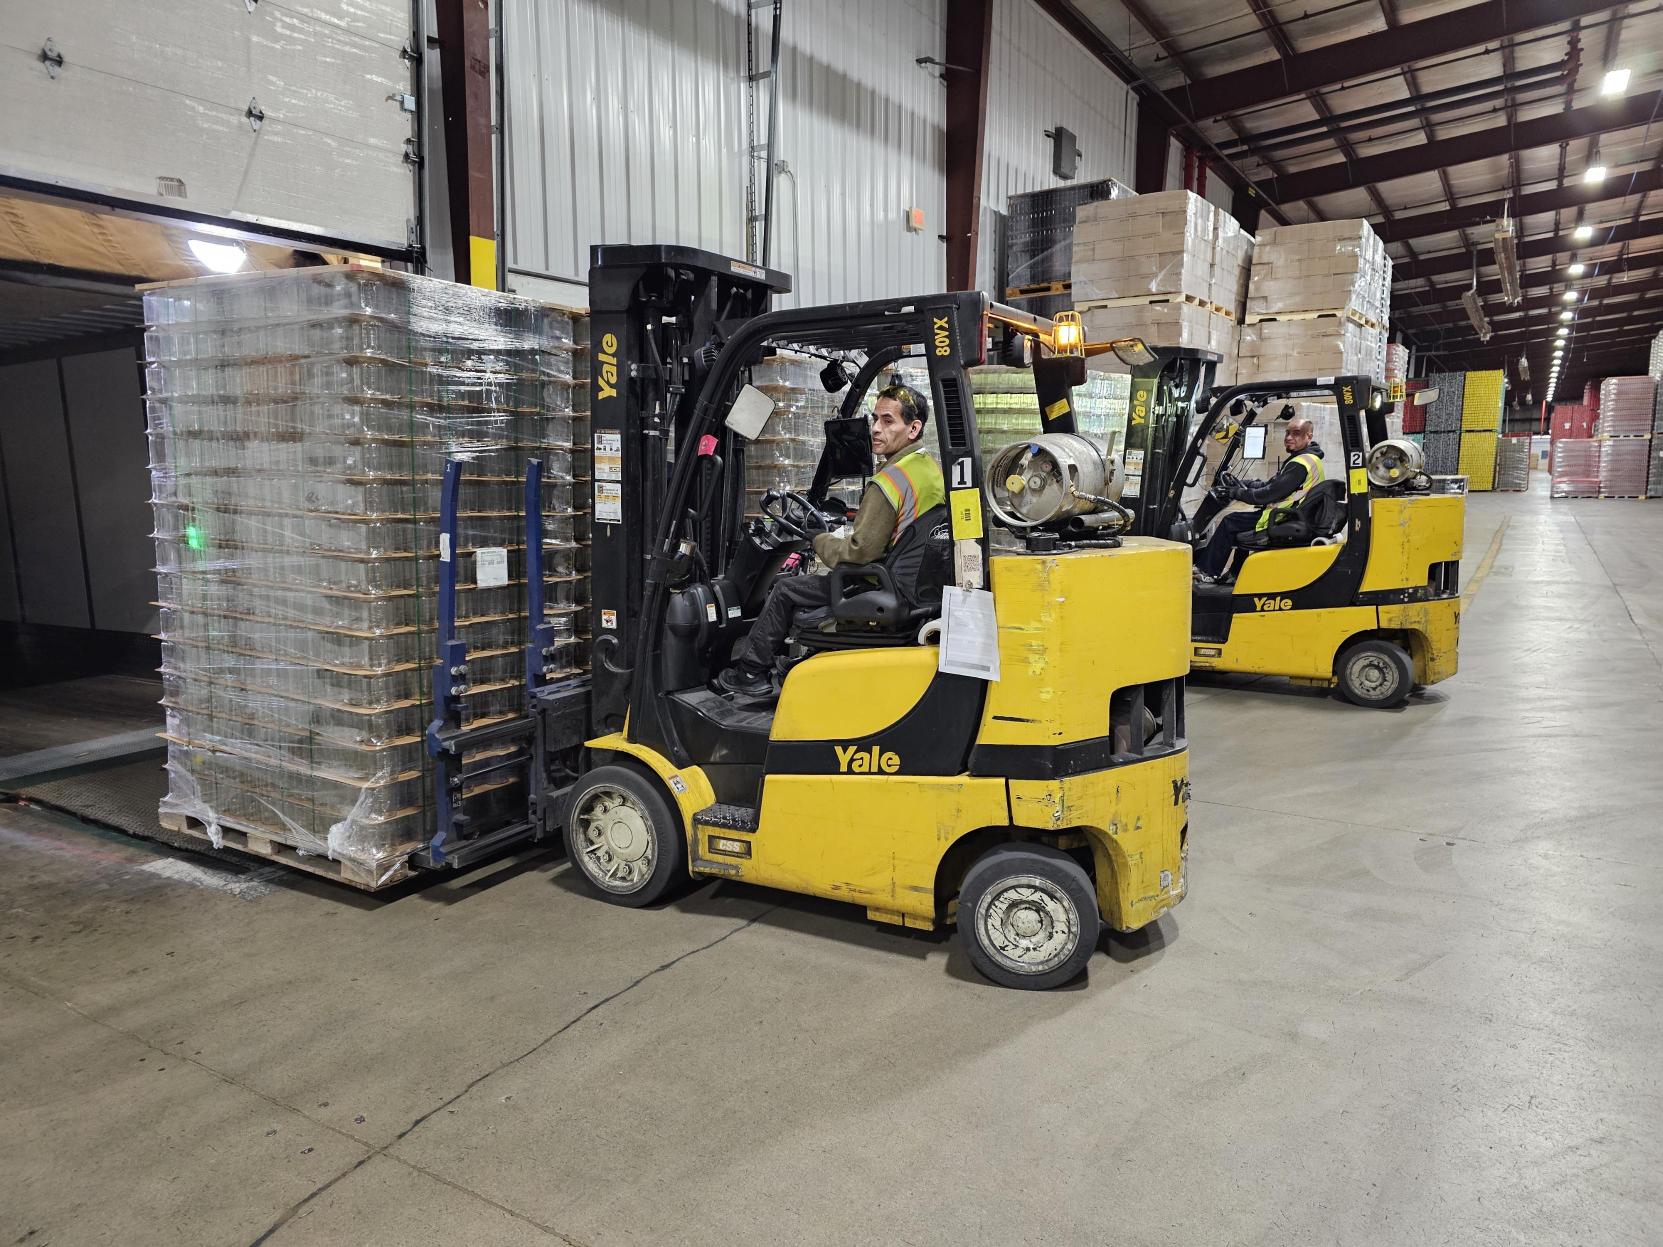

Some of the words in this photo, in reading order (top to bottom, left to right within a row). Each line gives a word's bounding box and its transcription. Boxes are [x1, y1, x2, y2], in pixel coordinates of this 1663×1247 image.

[934, 317, 950, 356] 80VX
[597, 333, 618, 400] Yale
[1131, 389, 1148, 426] Yale
[1343, 386, 1354, 405] 80VX
[1352, 453, 1361, 465] 2
[955, 460, 967, 485] 1
[1253, 597, 1293, 611] Yale
[835, 745, 901, 772] Yale
